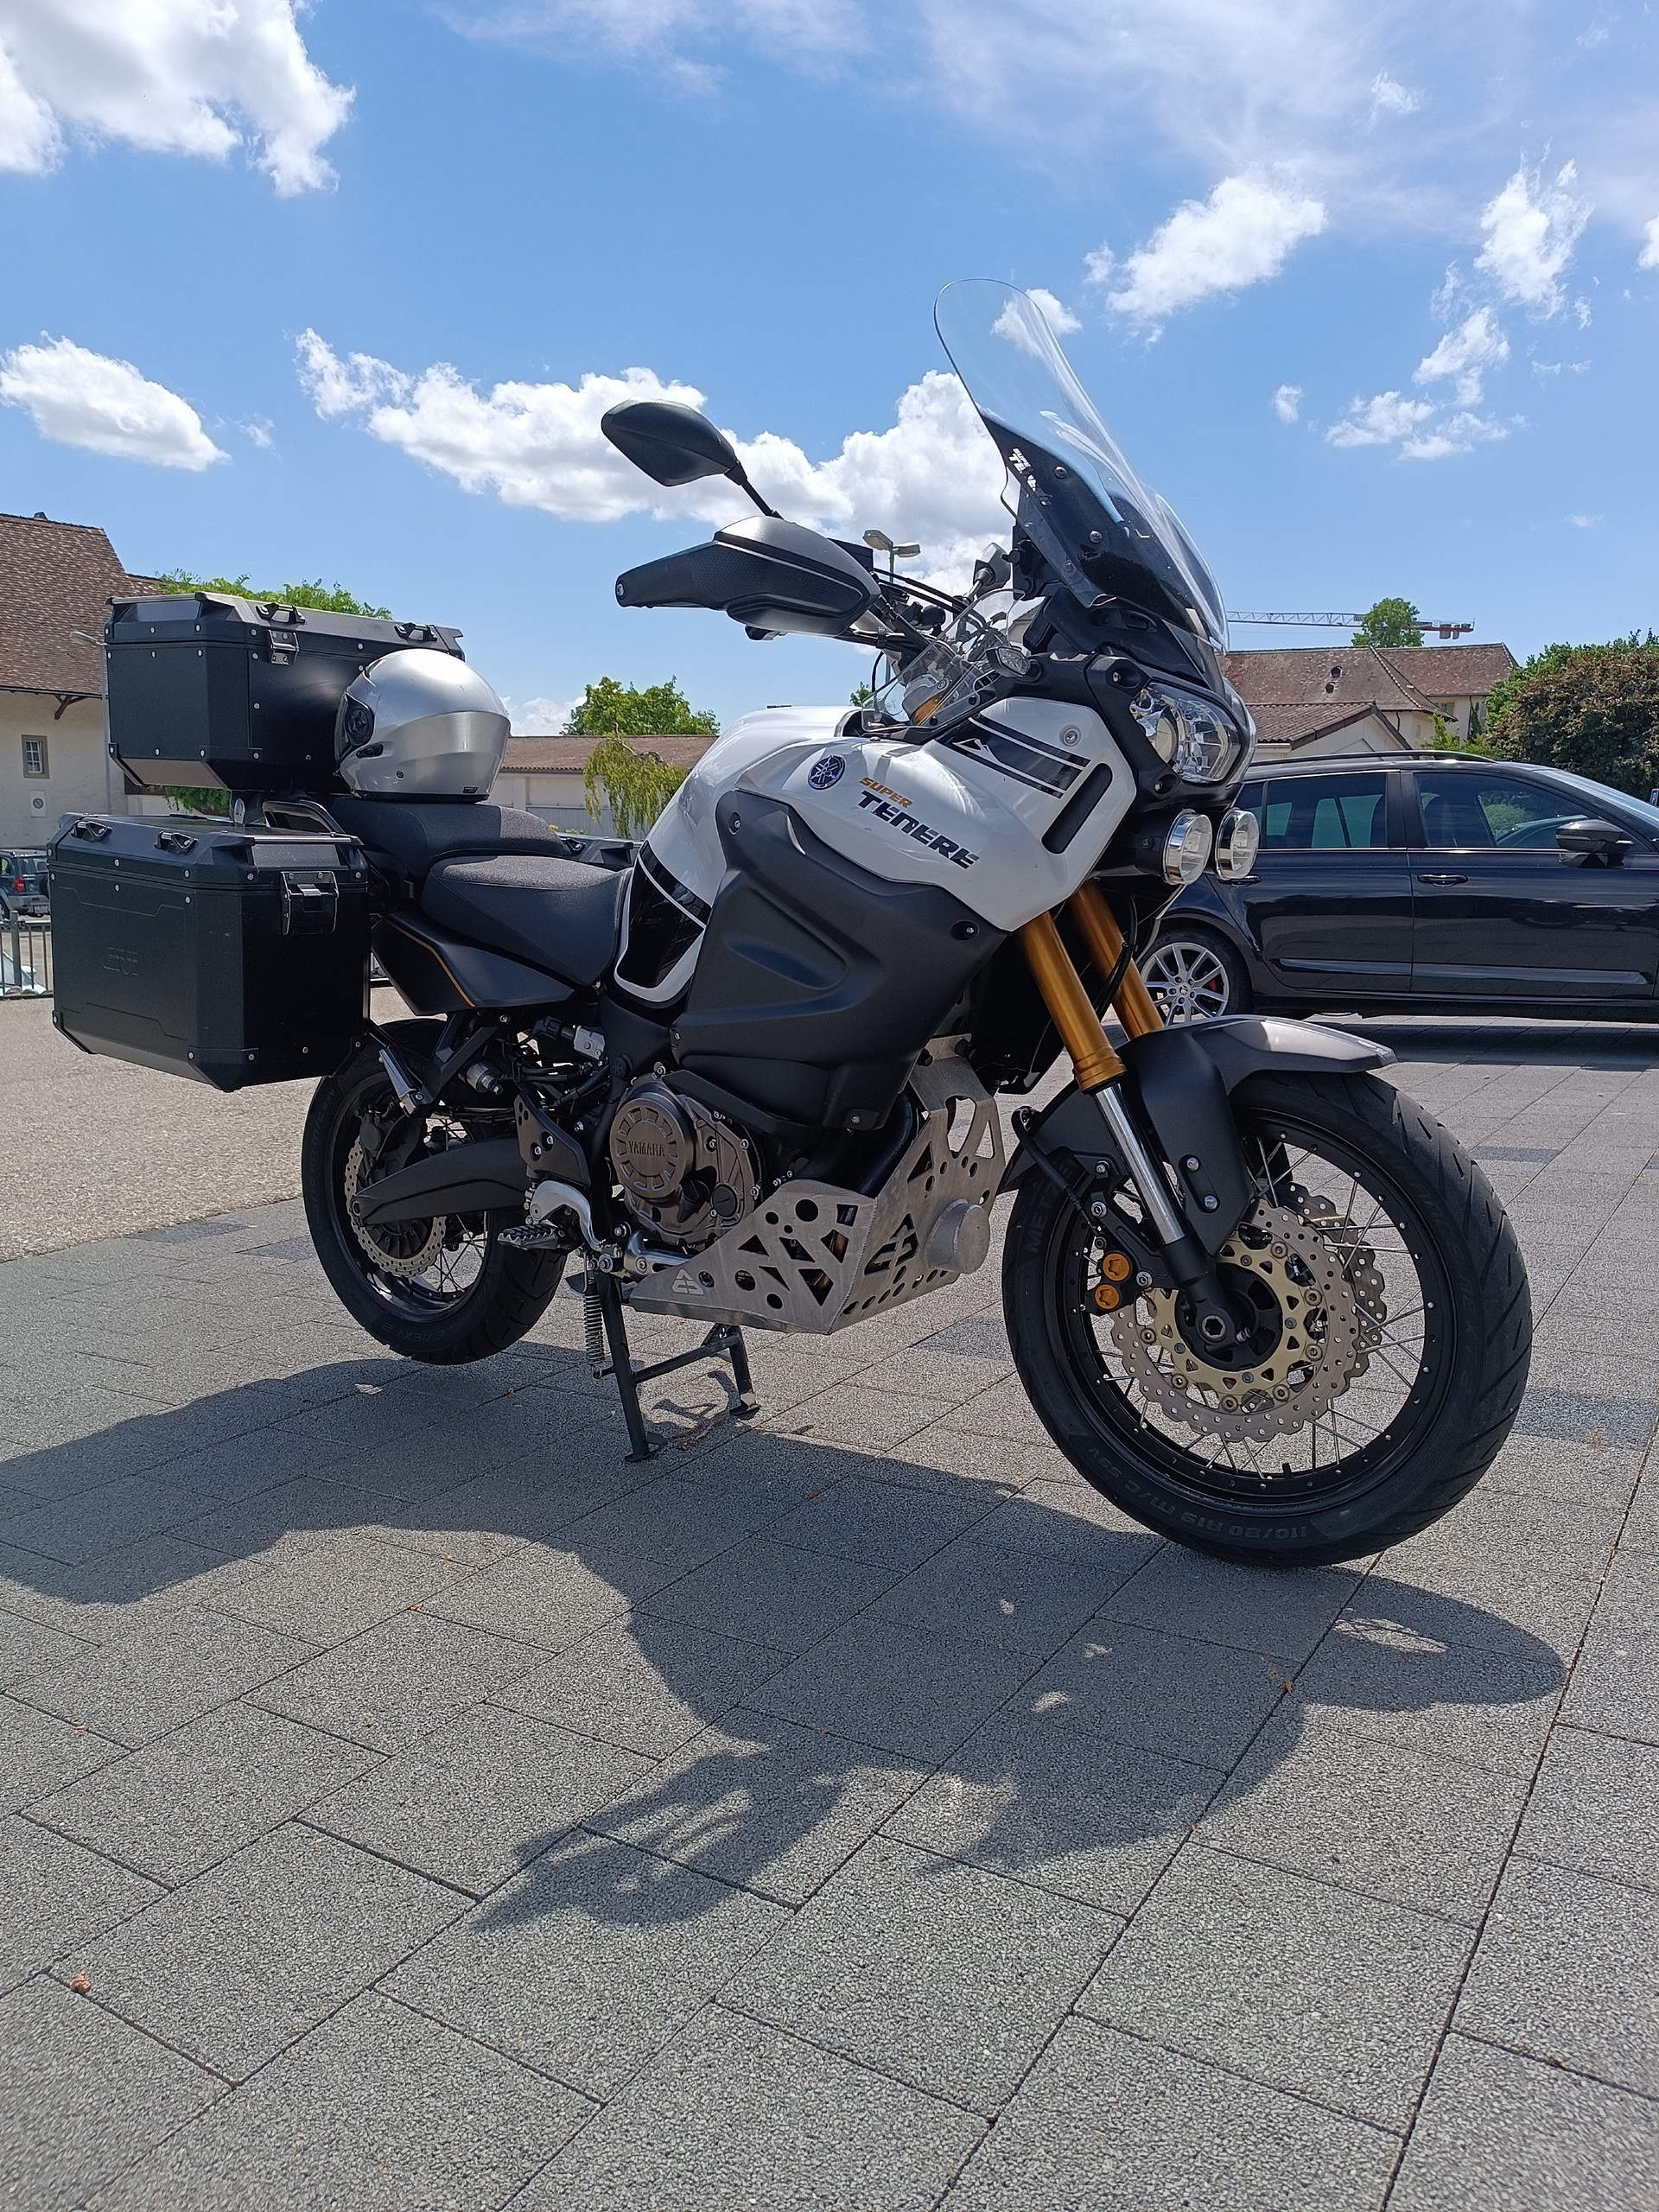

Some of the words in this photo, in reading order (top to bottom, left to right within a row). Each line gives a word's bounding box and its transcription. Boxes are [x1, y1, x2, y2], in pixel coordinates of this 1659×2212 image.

[860, 776, 913, 809] SUPER
[857, 790, 980, 870] TENERE
[628, 1141, 665, 1157] YAMAHA
[1180, 1510, 1224, 1534] R19
[1227, 1524, 1307, 1540] 110/80
